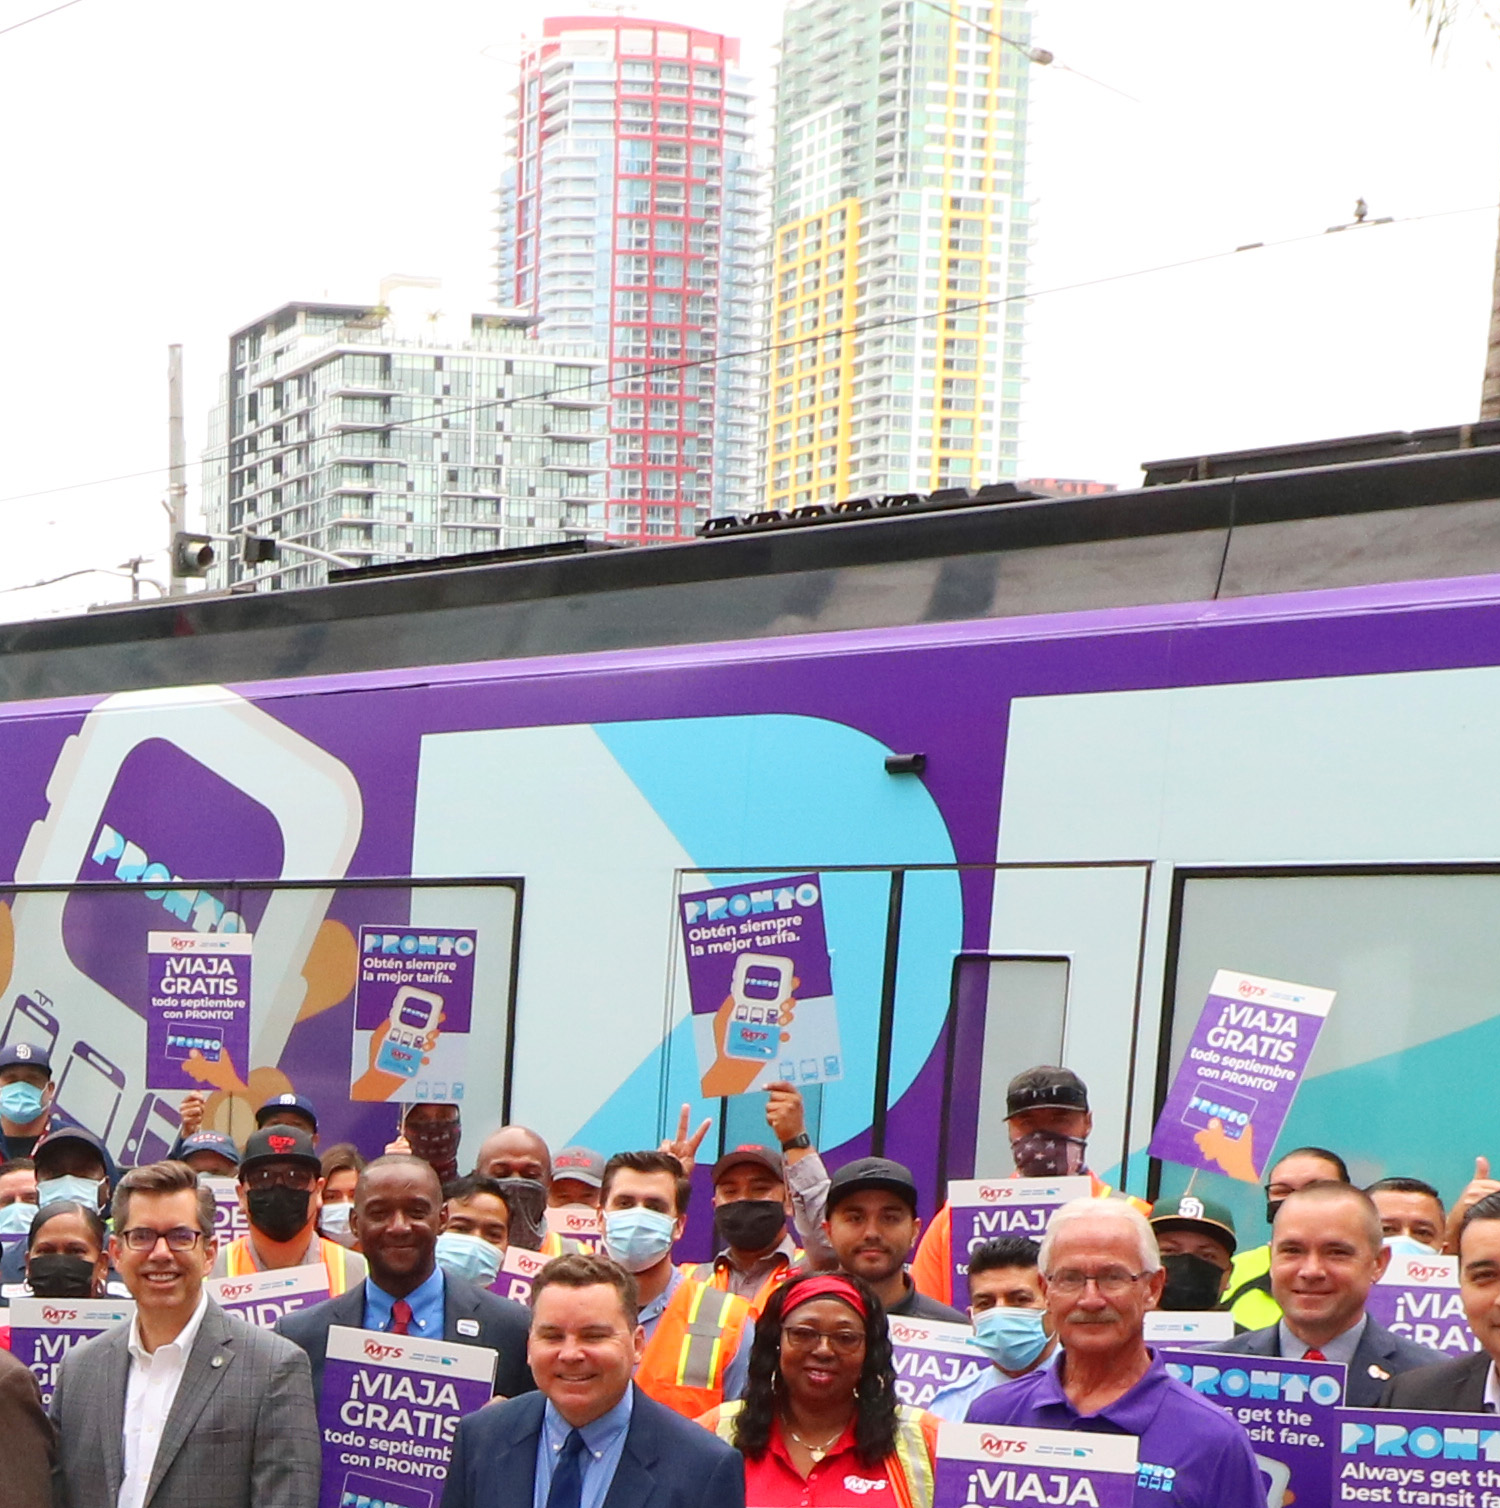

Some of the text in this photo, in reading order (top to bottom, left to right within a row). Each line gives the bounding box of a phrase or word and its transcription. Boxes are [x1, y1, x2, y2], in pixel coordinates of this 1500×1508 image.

[684, 883, 819, 925] PRONTO
[688, 915, 802, 941] Obtén siempre
[363, 934, 474, 956] PRONTO
[708, 930, 800, 954] mejor tarifa.
[165, 957, 235, 978] ¡VIAJA
[363, 956, 457, 973] Obtén siempre
[160, 977, 239, 996] GRATIS
[377, 970, 453, 985] mejor tarifa.
[151, 997, 246, 1010] todo septiembre
[185, 1009, 234, 1021] PRONTO!
[1218, 1003, 1299, 1038] ¡VIAJA
[1207, 1027, 1297, 1063] GRATIS
[1191, 1047, 1296, 1081] todo septiembre
[1221, 1070, 1278, 1093] PRONTO!
[350, 1370, 461, 1411] ¡VIAJA
[340, 1401, 461, 1442] GRATIS
[1238, 1405, 1313, 1427] get the
[324, 1429, 366, 1448] todo
[1280, 1429, 1325, 1448] fare.
[340, 1452, 371, 1468] con
[846, 1477, 888, 1493] MTS
[1340, 1463, 1425, 1486] Always
[1430, 1470, 1471, 1488] get
[967, 1468, 1100, 1508] ¡VIAJA
[1341, 1482, 1392, 1503] best
[1397, 1488, 1475, 1508] transit
